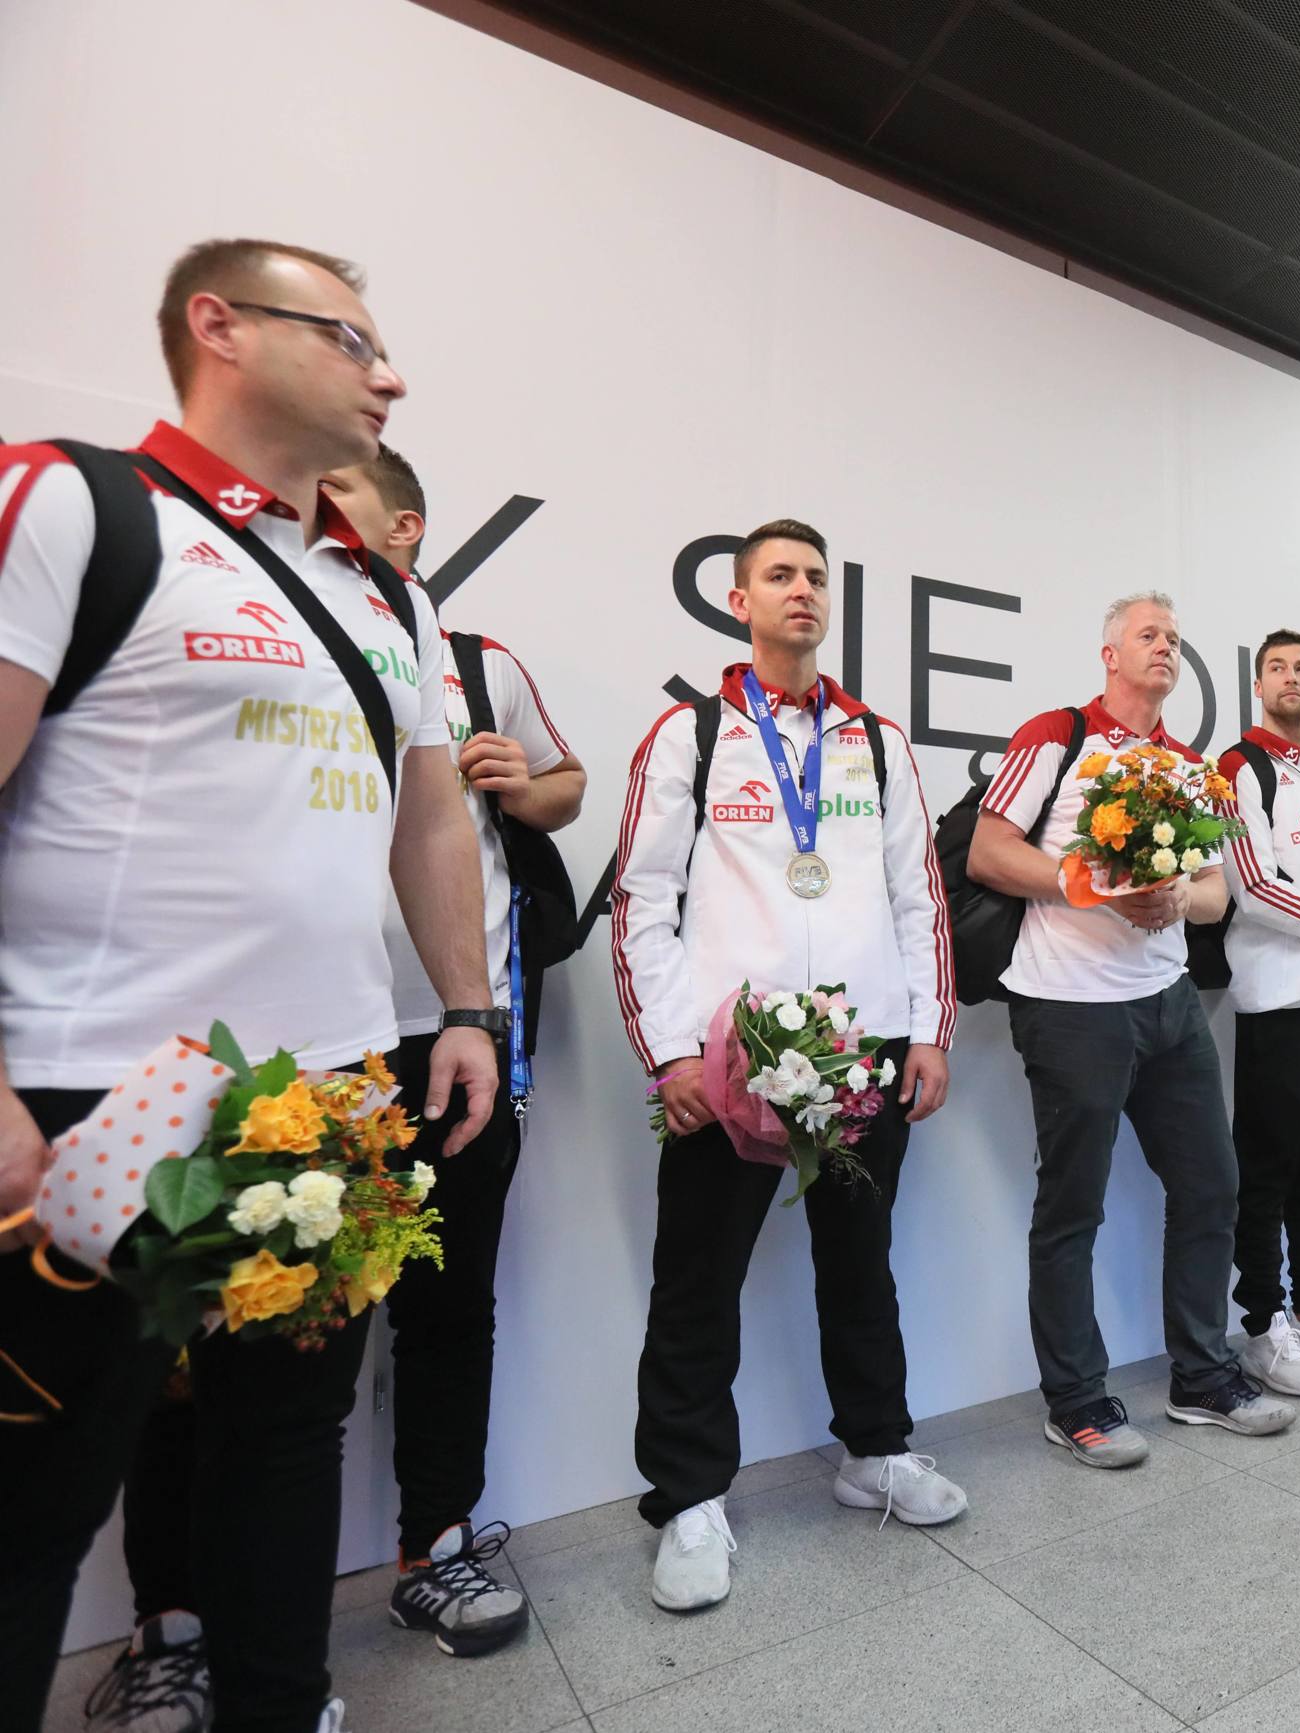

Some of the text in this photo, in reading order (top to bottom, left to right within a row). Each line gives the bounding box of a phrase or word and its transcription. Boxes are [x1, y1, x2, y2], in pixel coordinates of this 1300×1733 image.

[192, 636, 302, 664] ORLEN
[363, 646, 420, 687] plu
[234, 697, 341, 752] MISTRZ
[720, 733, 752, 741] adidas
[839, 737, 869, 745] POLS
[309, 767, 378, 813] 2018
[715, 807, 771, 820] ORLEN
[816, 793, 875, 823] plus
